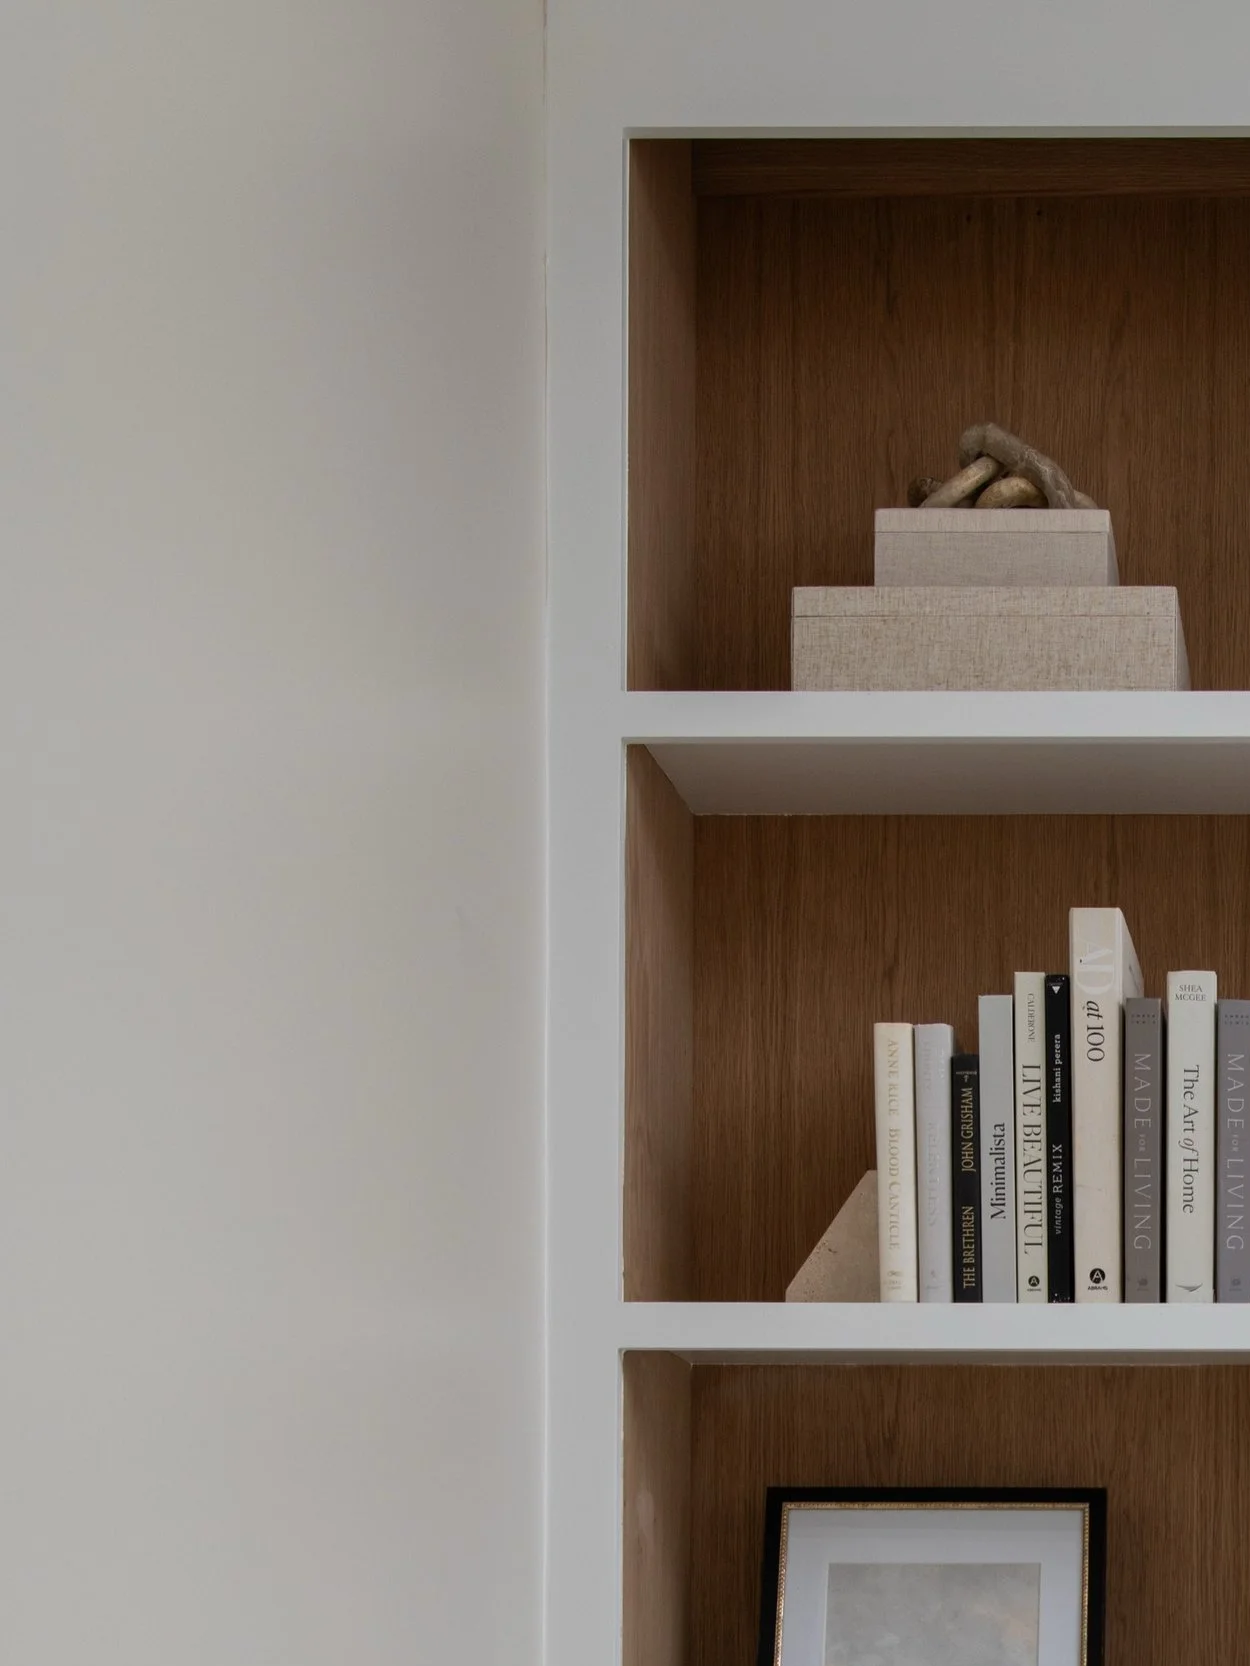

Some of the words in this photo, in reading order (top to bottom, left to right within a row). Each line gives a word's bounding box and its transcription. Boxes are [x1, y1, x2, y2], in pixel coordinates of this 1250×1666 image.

[1179, 985, 1202, 993] SHEA
[1027, 993, 1036, 1042] CALDERONE
[1086, 1000, 1103, 1020] at
[888, 1038, 900, 1079] ANNE
[1054, 1034, 1063, 1065] perera
[1086, 1024, 1105, 1062] 100
[888, 1083, 900, 1116] RICE
[1022, 1064, 1042, 1116] LIVE
[1052, 1068, 1061, 1103] kishani
[1134, 1054, 1151, 1129] MADE
[1183, 1065, 1199, 1101] The
[1227, 1054, 1245, 1129] MADE
[961, 1087, 974, 1139] GRISHAM
[1183, 1104, 1199, 1133] Art
[888, 1127, 901, 1177] BLOOD
[961, 1141, 976, 1172] JOHN
[1138, 1134, 1146, 1152] FOR
[1178, 1137, 1199, 1156] of
[1231, 1134, 1239, 1152] FOR
[989, 1122, 1006, 1219] Minimalista
[1052, 1144, 1063, 1193] REMIX
[1182, 1158, 1198, 1214] Home
[1023, 1124, 1043, 1255] BEAUTIFUL
[1133, 1158, 1151, 1250] LIVING
[1226, 1158, 1244, 1250] LIVING
[888, 1181, 901, 1250] CANTICLE
[962, 1206, 975, 1263] BRETHREN
[1054, 1197, 1063, 1235] vintage
[963, 1267, 976, 1288] THE
